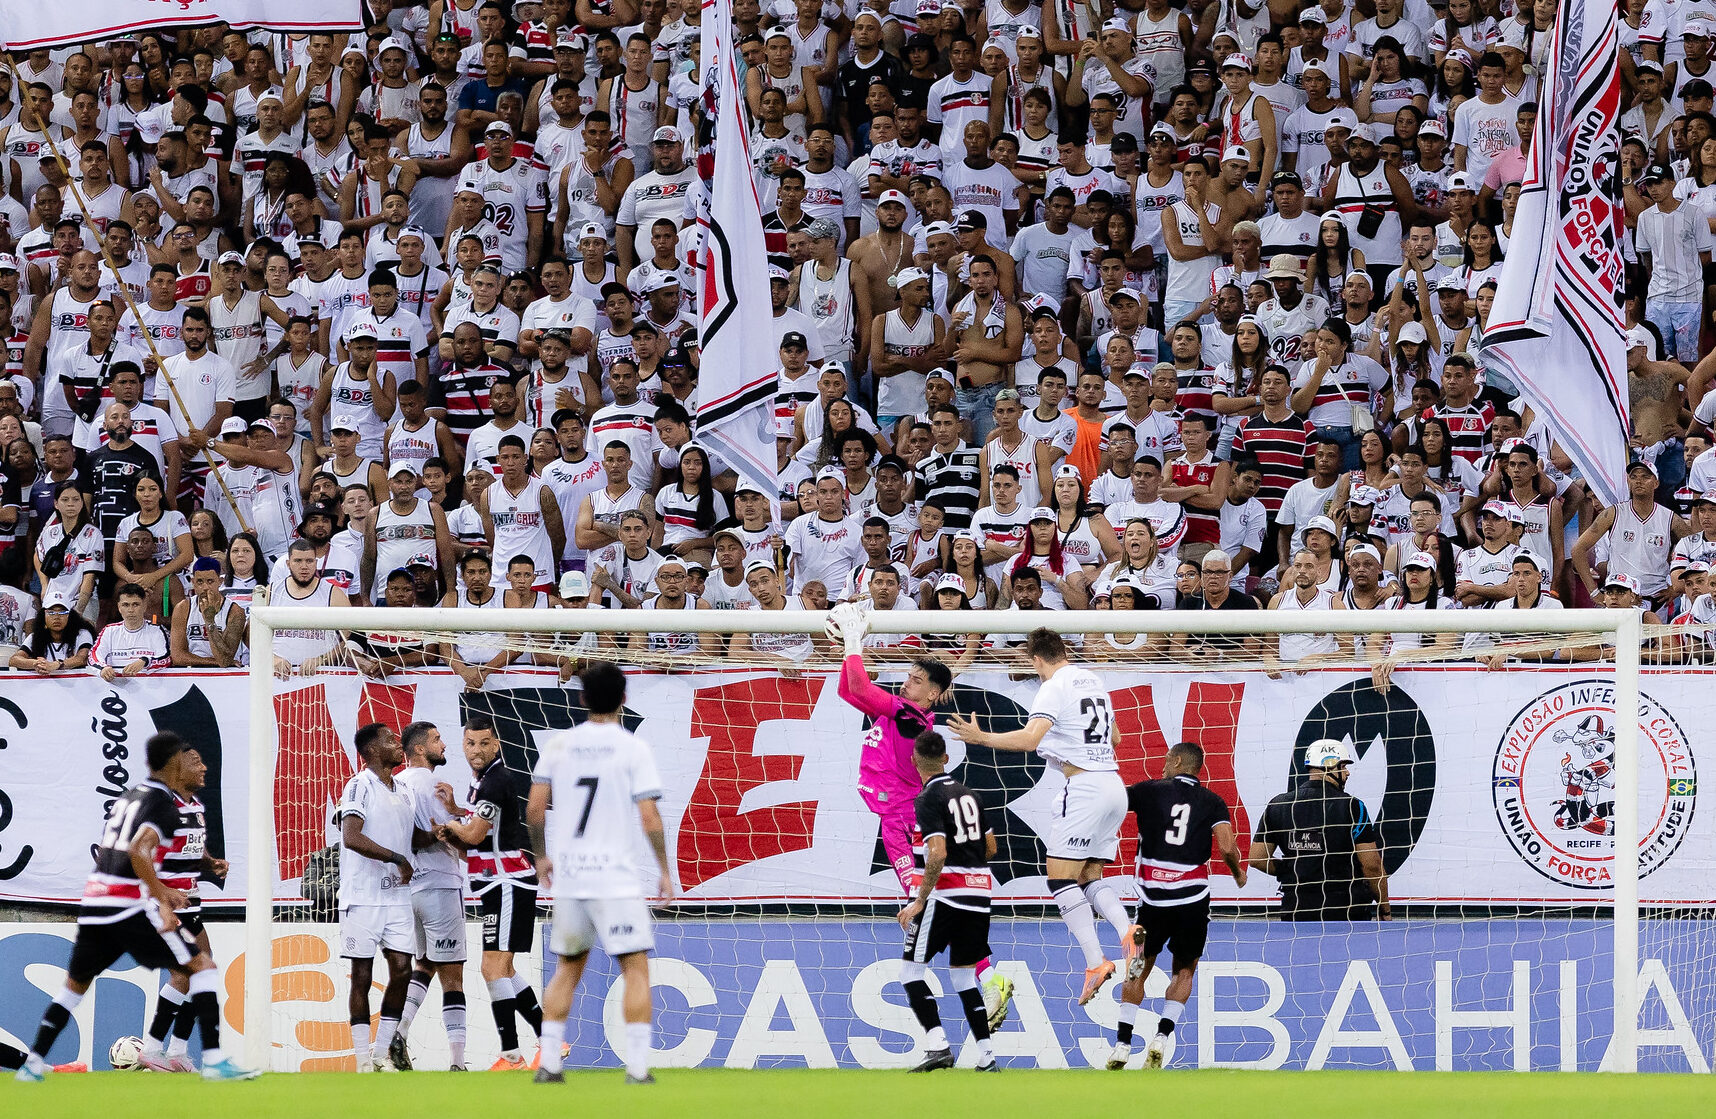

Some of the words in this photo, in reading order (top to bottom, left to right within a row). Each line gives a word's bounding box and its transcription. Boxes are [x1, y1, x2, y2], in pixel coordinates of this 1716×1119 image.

[1564, 110, 1603, 194] UNIÃO,
[478, 201, 516, 232] 92
[1571, 197, 1612, 269] FORÇA
[484, 235, 499, 250] 92
[894, 345, 925, 358] SCFC
[1267, 335, 1303, 363] 92
[516, 512, 540, 527] CRUZ
[1501, 695, 1564, 775] EXPLOSÃO
[1570, 687, 1651, 718] INFEO
[1649, 717, 1688, 775] CORAL
[102, 797, 142, 851] 21
[575, 776, 599, 839] 7
[947, 794, 982, 845] 19
[1164, 802, 1188, 846] 3
[1301, 832, 1311, 841] AK
[1504, 797, 1542, 863] UNIÃO,
[1547, 855, 1612, 885] FORÇA
[1566, 840, 1602, 849] RECIFE
